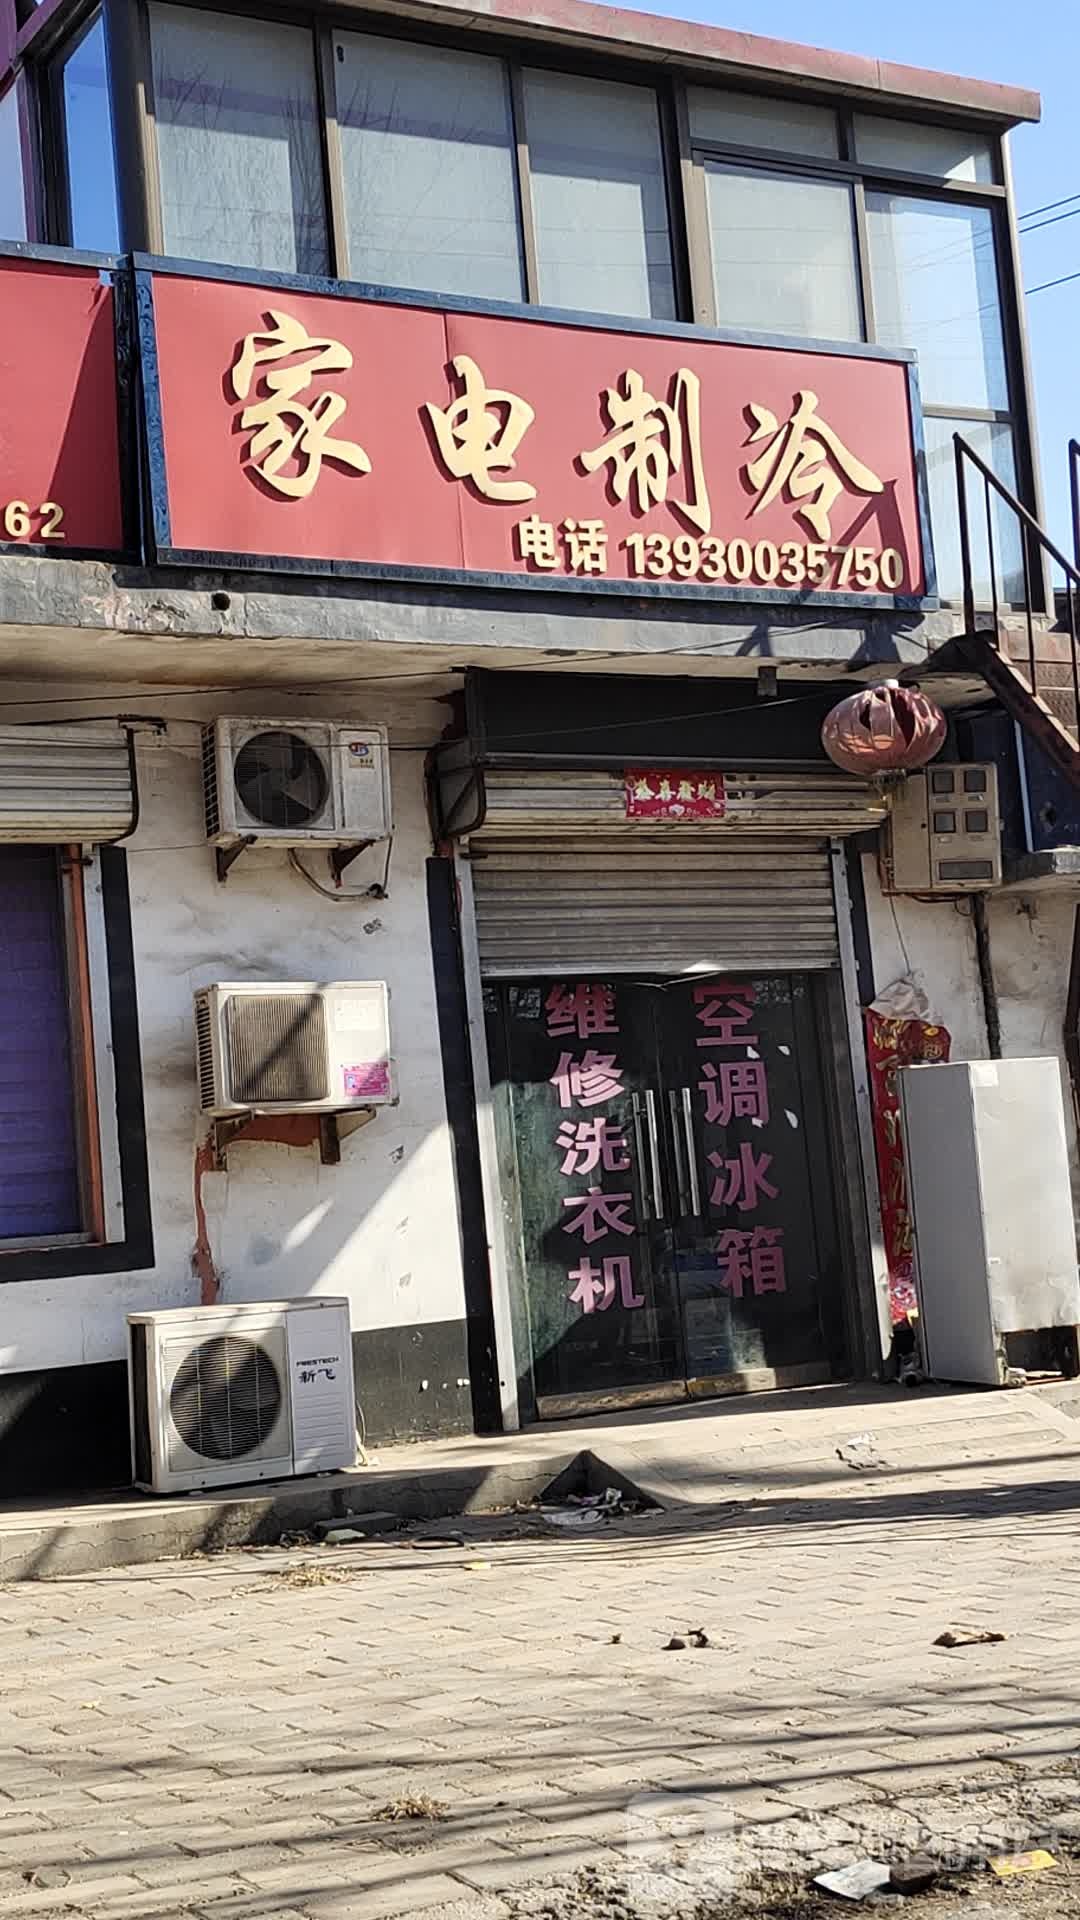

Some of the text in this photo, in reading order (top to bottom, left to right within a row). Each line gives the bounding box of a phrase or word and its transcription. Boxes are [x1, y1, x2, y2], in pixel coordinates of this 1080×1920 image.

[228, 309, 884, 541] 家电制冷
[4, 501, 65, 538] 62
[518, 514, 904, 589] 电话 13930035750
[545, 983, 645, 1314] 维修洗衣机
[693, 981, 786, 1298] 空调冰箱
[298, 1368, 336, 1384] 新飞
